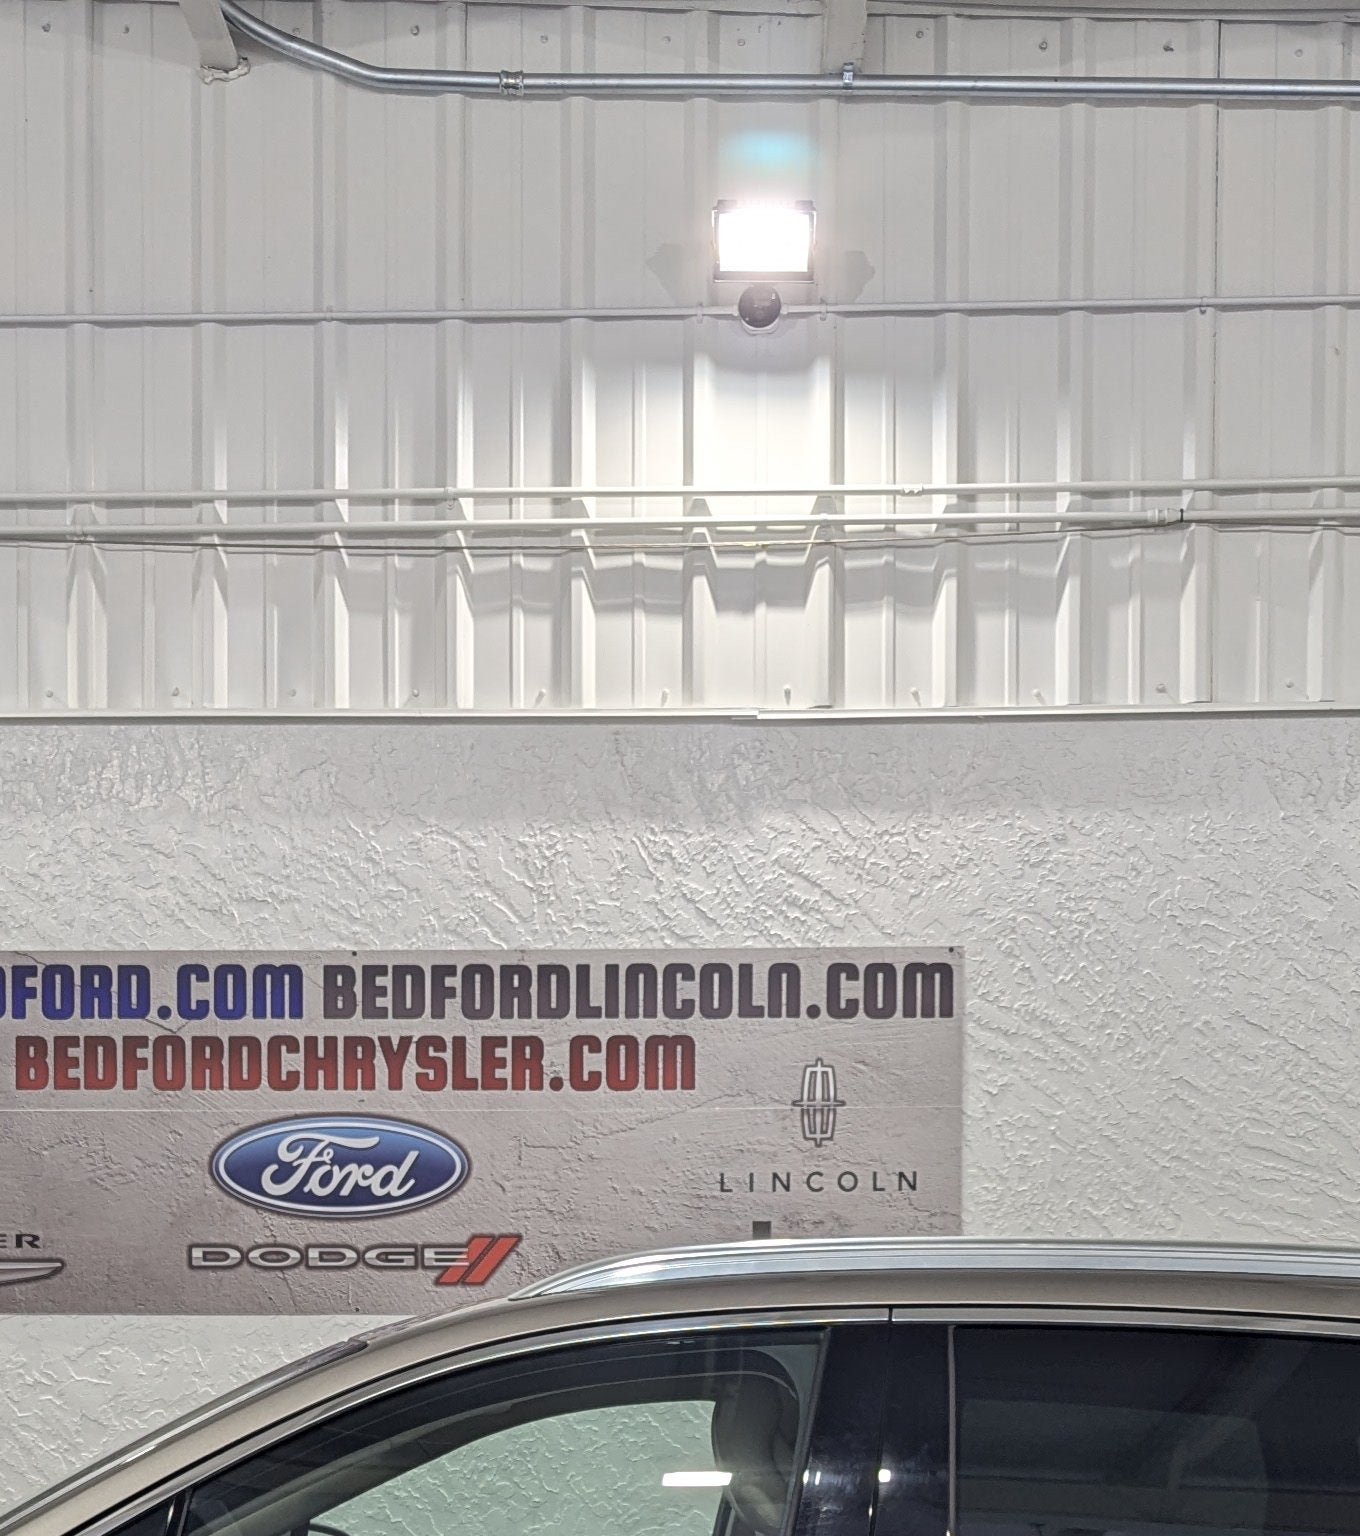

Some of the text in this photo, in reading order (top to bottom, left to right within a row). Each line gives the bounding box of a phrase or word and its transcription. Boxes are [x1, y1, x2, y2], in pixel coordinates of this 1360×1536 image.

[323, 962, 954, 1020] BEDFORDLINCOLN.COM
[15, 1034, 696, 1091] BEDFORDCHRYSLER.COM
[261, 1132, 420, 1197] Ford
[719, 1171, 918, 1193] LINCOLN
[190, 1245, 470, 1269] DODGE
